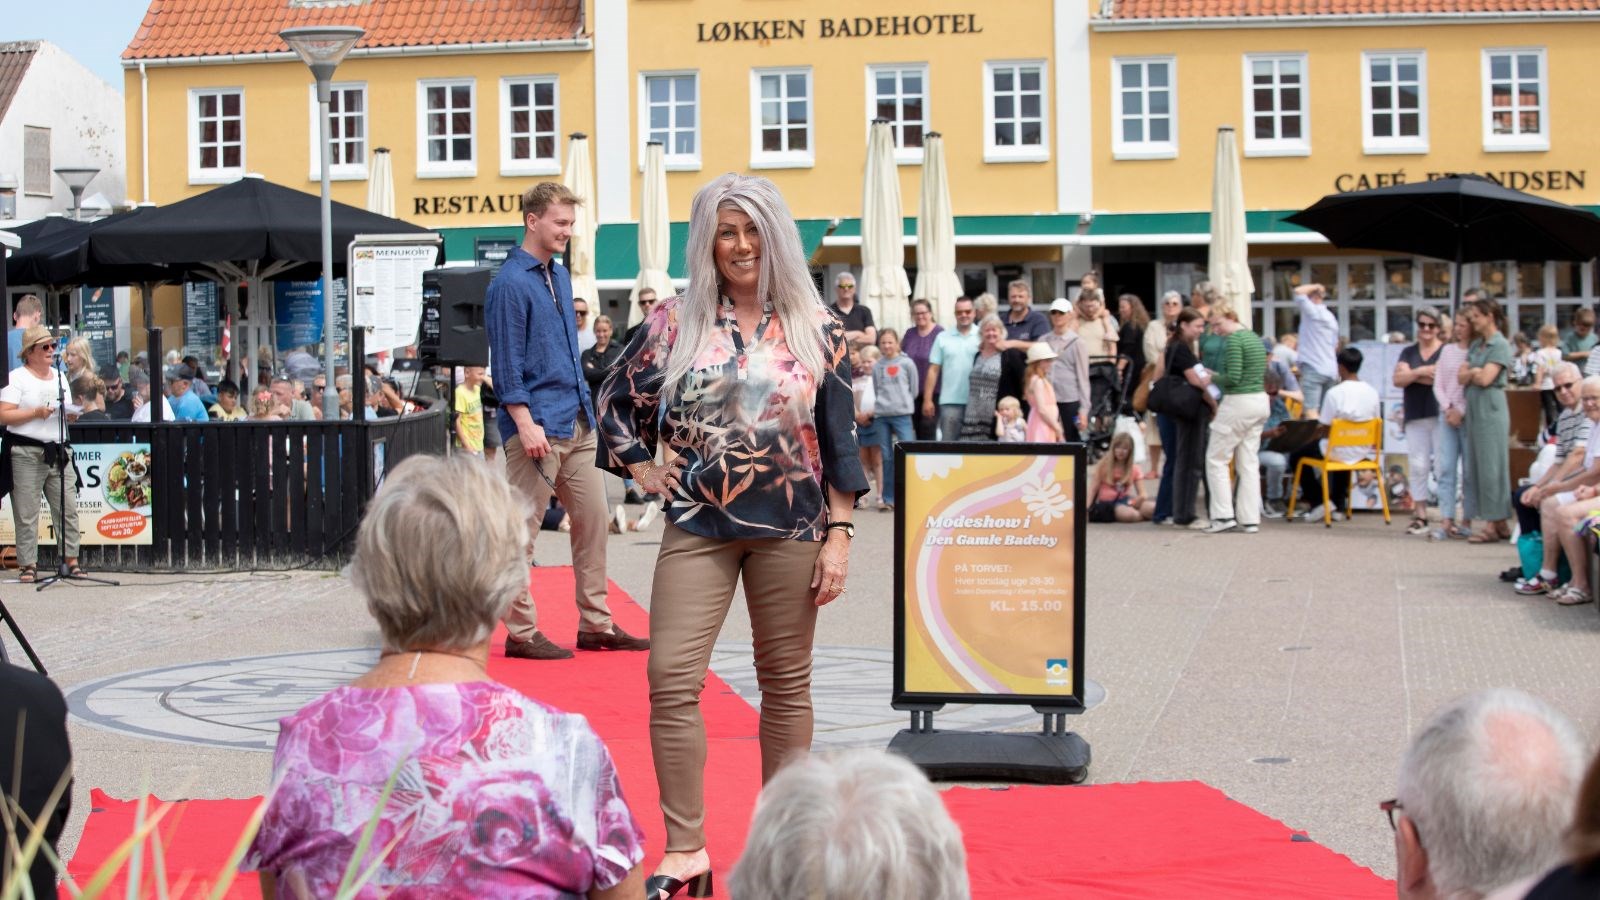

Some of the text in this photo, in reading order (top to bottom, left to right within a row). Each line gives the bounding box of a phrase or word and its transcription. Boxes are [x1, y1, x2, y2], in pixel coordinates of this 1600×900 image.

[697, 14, 983, 42] LØKKEN BADEHOTEL
[1335, 169, 1586, 193] CAFÉ NDSEN
[376, 248, 430, 256] MENUKORT
[926, 515, 1031, 529] Modeshow i
[925, 534, 1057, 548] Den Gamle Badeby
[954, 563, 1013, 573] PÅ TORVET:
[954, 577, 975, 585] Hver
[1011, 578, 1027, 587] uge
[990, 600, 1062, 611] KL. 15.00
